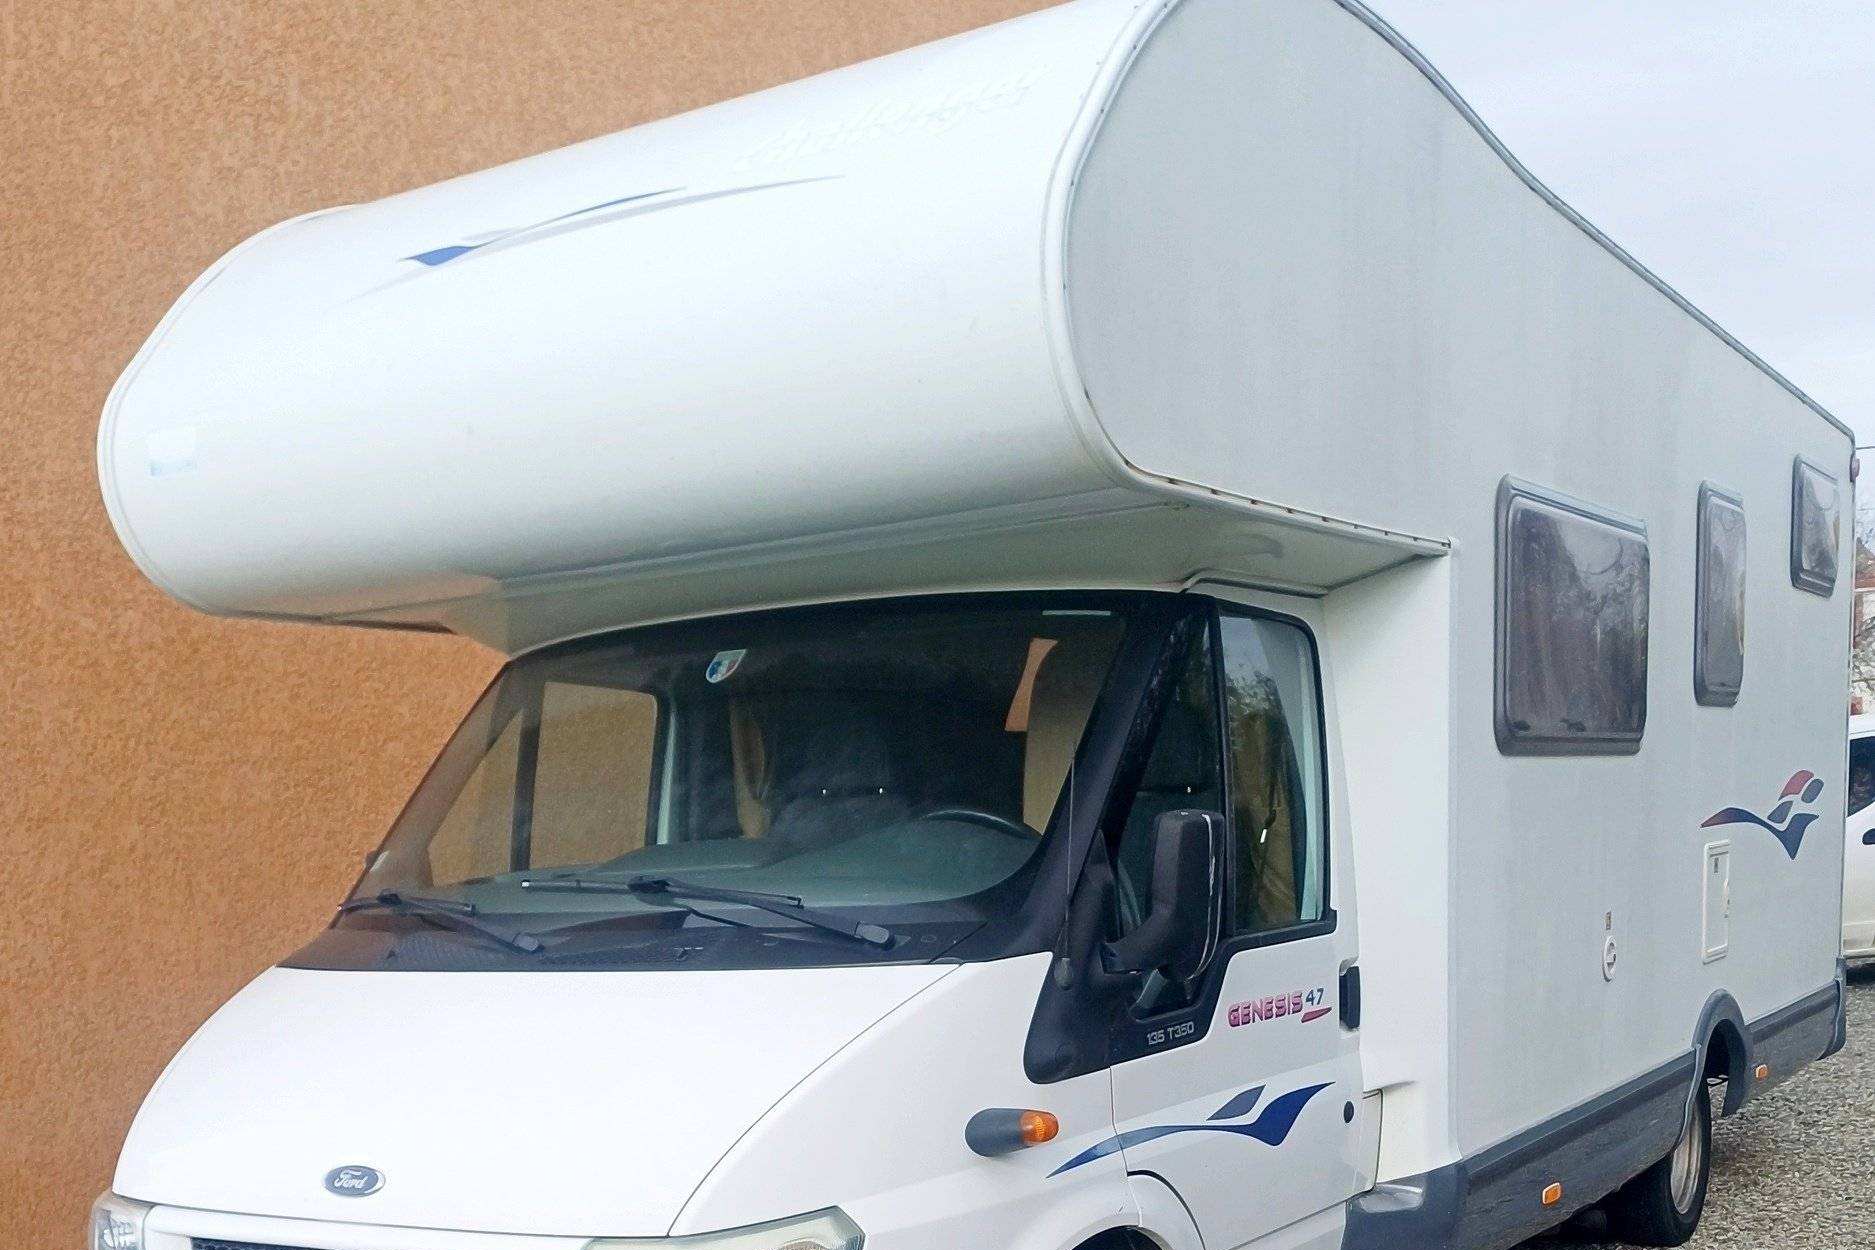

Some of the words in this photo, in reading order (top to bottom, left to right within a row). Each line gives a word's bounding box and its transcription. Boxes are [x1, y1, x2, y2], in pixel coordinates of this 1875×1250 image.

[1228, 989, 1303, 1028] GENESIS
[1305, 987, 1324, 1006] 47
[333, 1169, 369, 1189] Ford
